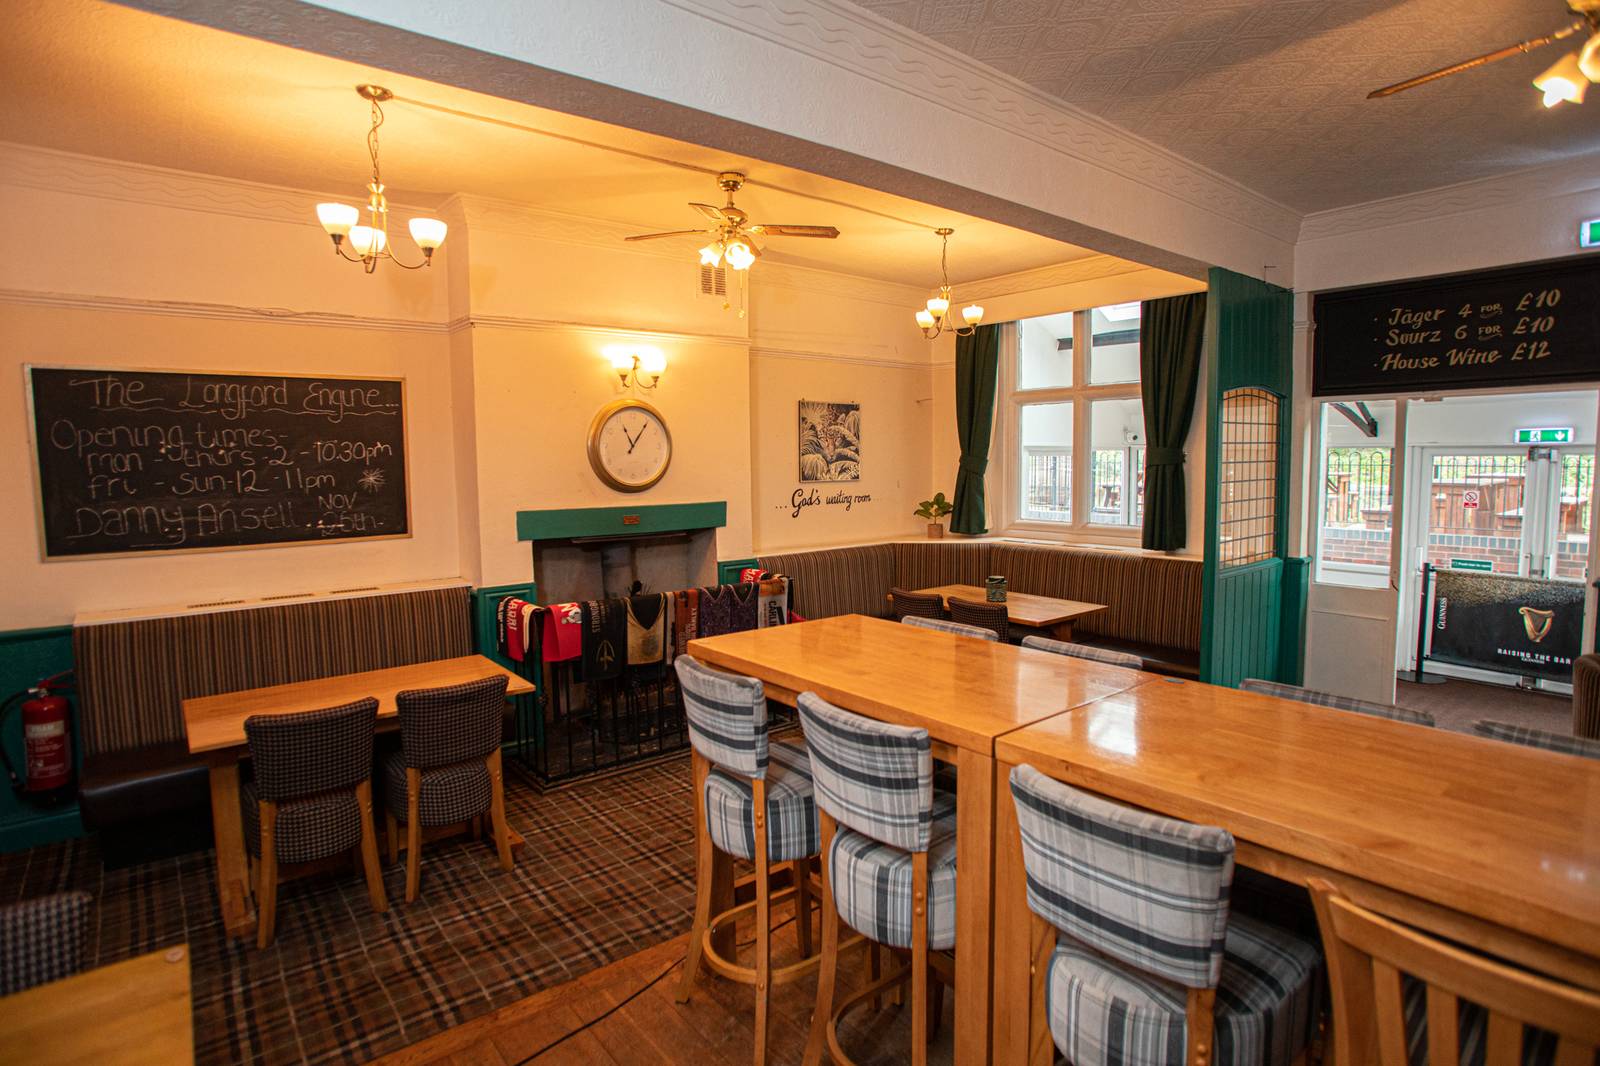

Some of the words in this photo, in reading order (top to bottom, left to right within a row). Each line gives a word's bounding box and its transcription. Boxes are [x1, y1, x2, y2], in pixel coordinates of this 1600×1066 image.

[1388, 308, 1446, 330] Jäger
[1458, 303, 1473, 318] 4
[1480, 303, 1503, 313] FOR
[1515, 289, 1561, 312] £10
[1454, 325, 1468, 340] 6
[1478, 325, 1503, 335] FOR
[1512, 316, 1555, 335] £10
[1381, 353, 1440, 371] House
[1446, 348, 1502, 366] Wine
[1510, 341, 1552, 361] £12
[68, 374, 164, 406] The
[51, 419, 193, 461] Opening
[183, 449, 256, 467] thurs
[88, 475, 137, 499] fri
[826, 491, 853, 512] waiting
[854, 494, 872, 504] room
[66, 504, 187, 549] Danny
[197, 500, 301, 537] Ansell
[588, 600, 600, 633] STRONGB
[1436, 597, 1448, 630] GUINNESS
[1497, 648, 1531, 659] RAISING
[1534, 653, 1551, 662] THE
[1554, 656, 1571, 665] BAR
